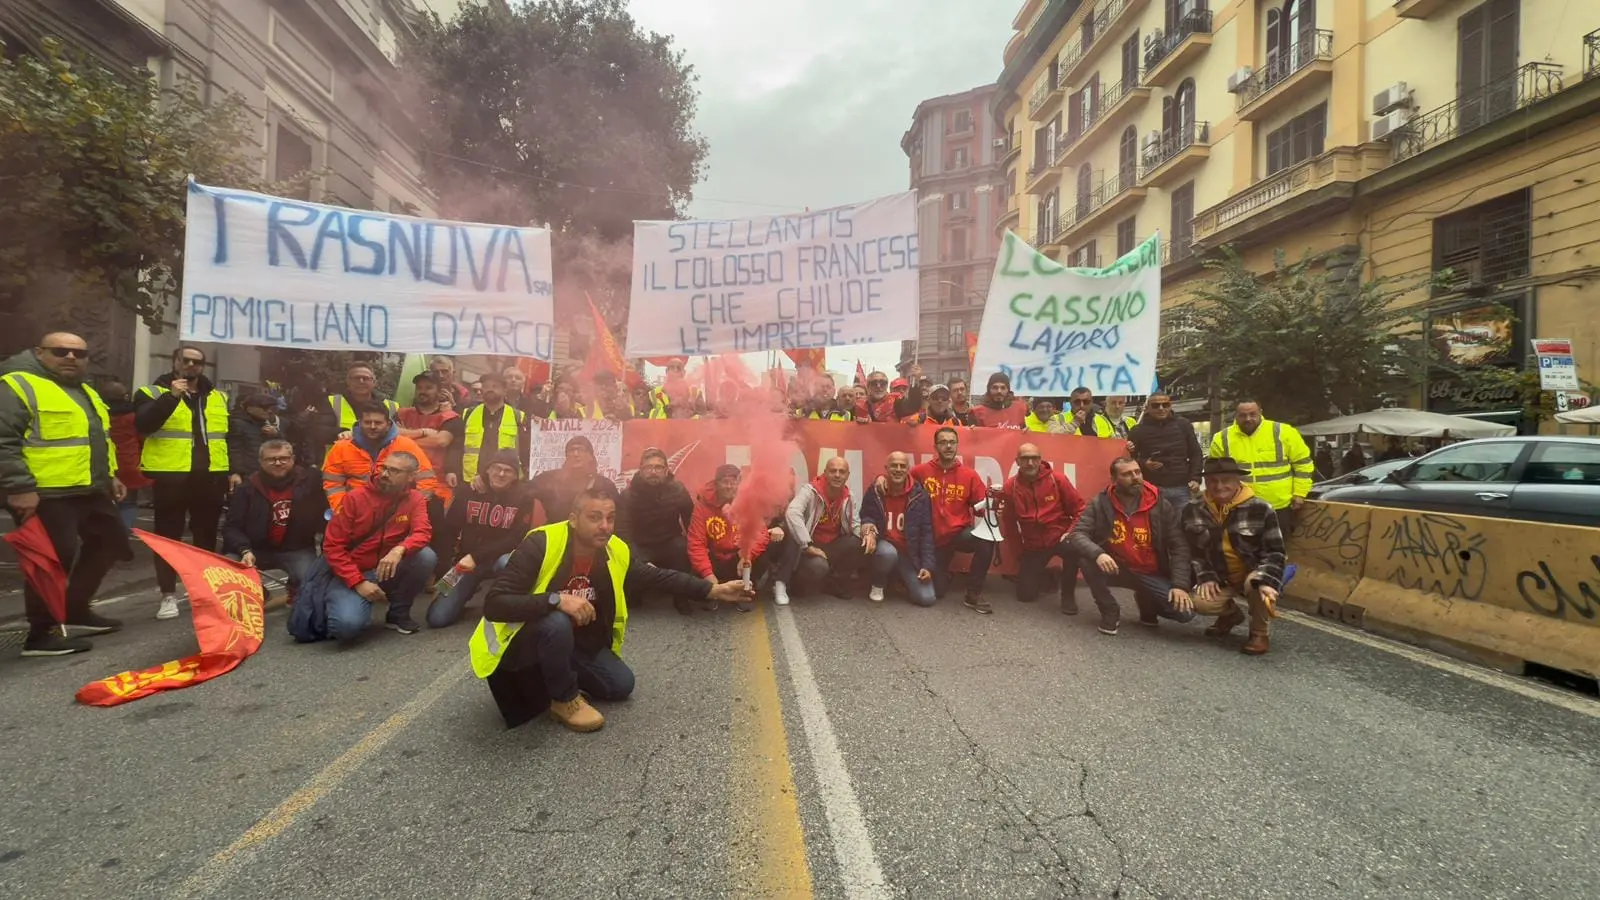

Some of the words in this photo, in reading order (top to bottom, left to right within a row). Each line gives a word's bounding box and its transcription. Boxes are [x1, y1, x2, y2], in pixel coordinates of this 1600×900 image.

[198, 192, 533, 295] TRASNOVA
[669, 207, 855, 252] STELLANTIS
[644, 263, 666, 290] IL
[674, 250, 783, 289] COLOSSO
[799, 233, 918, 280] FRANCESE
[691, 292, 746, 324] CHE
[777, 279, 882, 320] CHIUDE
[1009, 290, 1146, 325] CASSINO
[191, 293, 389, 348] POMIGLIANO
[433, 306, 552, 358] D'ARCO
[680, 327, 712, 354] LE
[734, 319, 874, 351] IMPRESE...
[1009, 320, 1121, 353] LAVORO
[1050, 353, 1065, 365] E
[540, 419, 582, 431] NATALE
